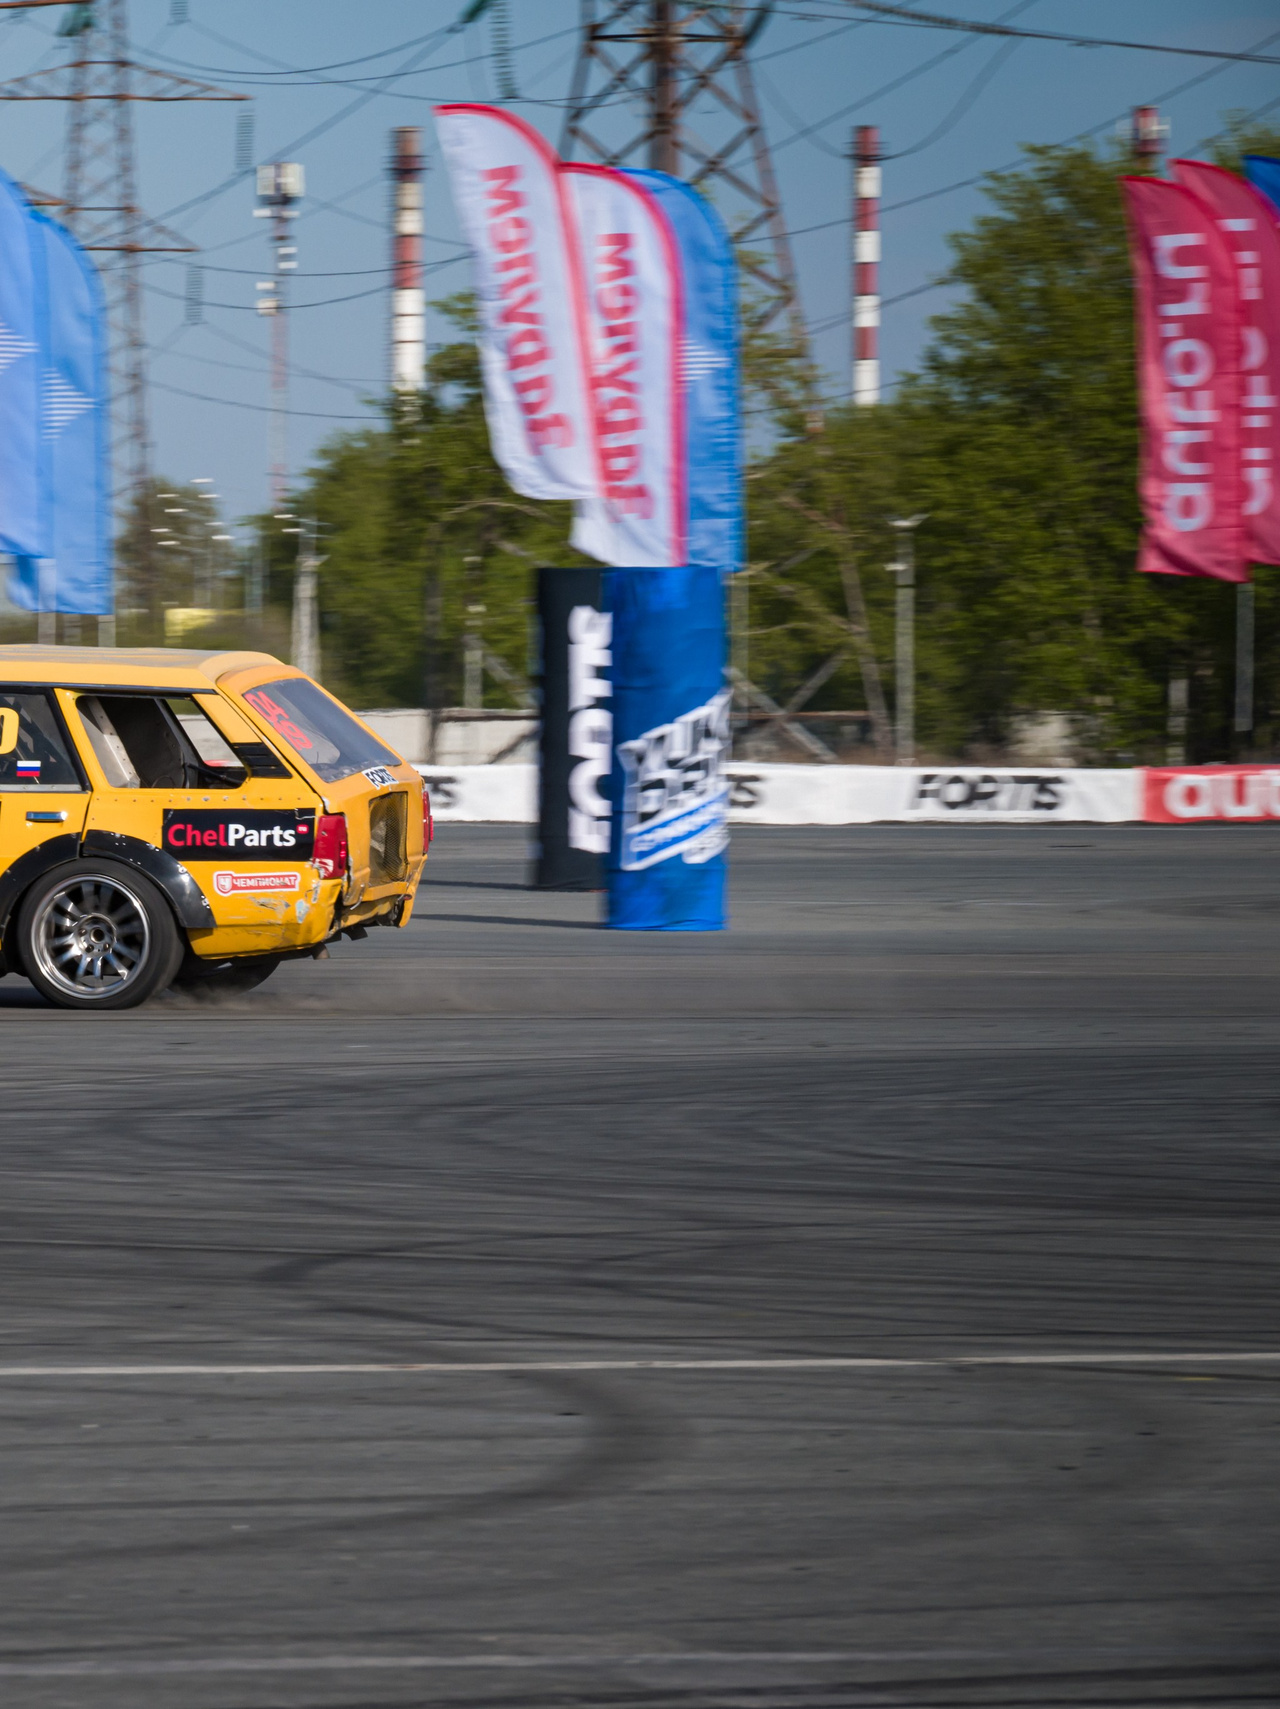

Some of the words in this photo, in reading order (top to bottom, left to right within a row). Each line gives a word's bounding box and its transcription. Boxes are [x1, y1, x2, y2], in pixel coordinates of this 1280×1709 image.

[908, 774, 1067, 811] FORTS
[167, 823, 296, 847] ChelParts
[233, 876, 296, 888] ЧЕМПИОНАТ
